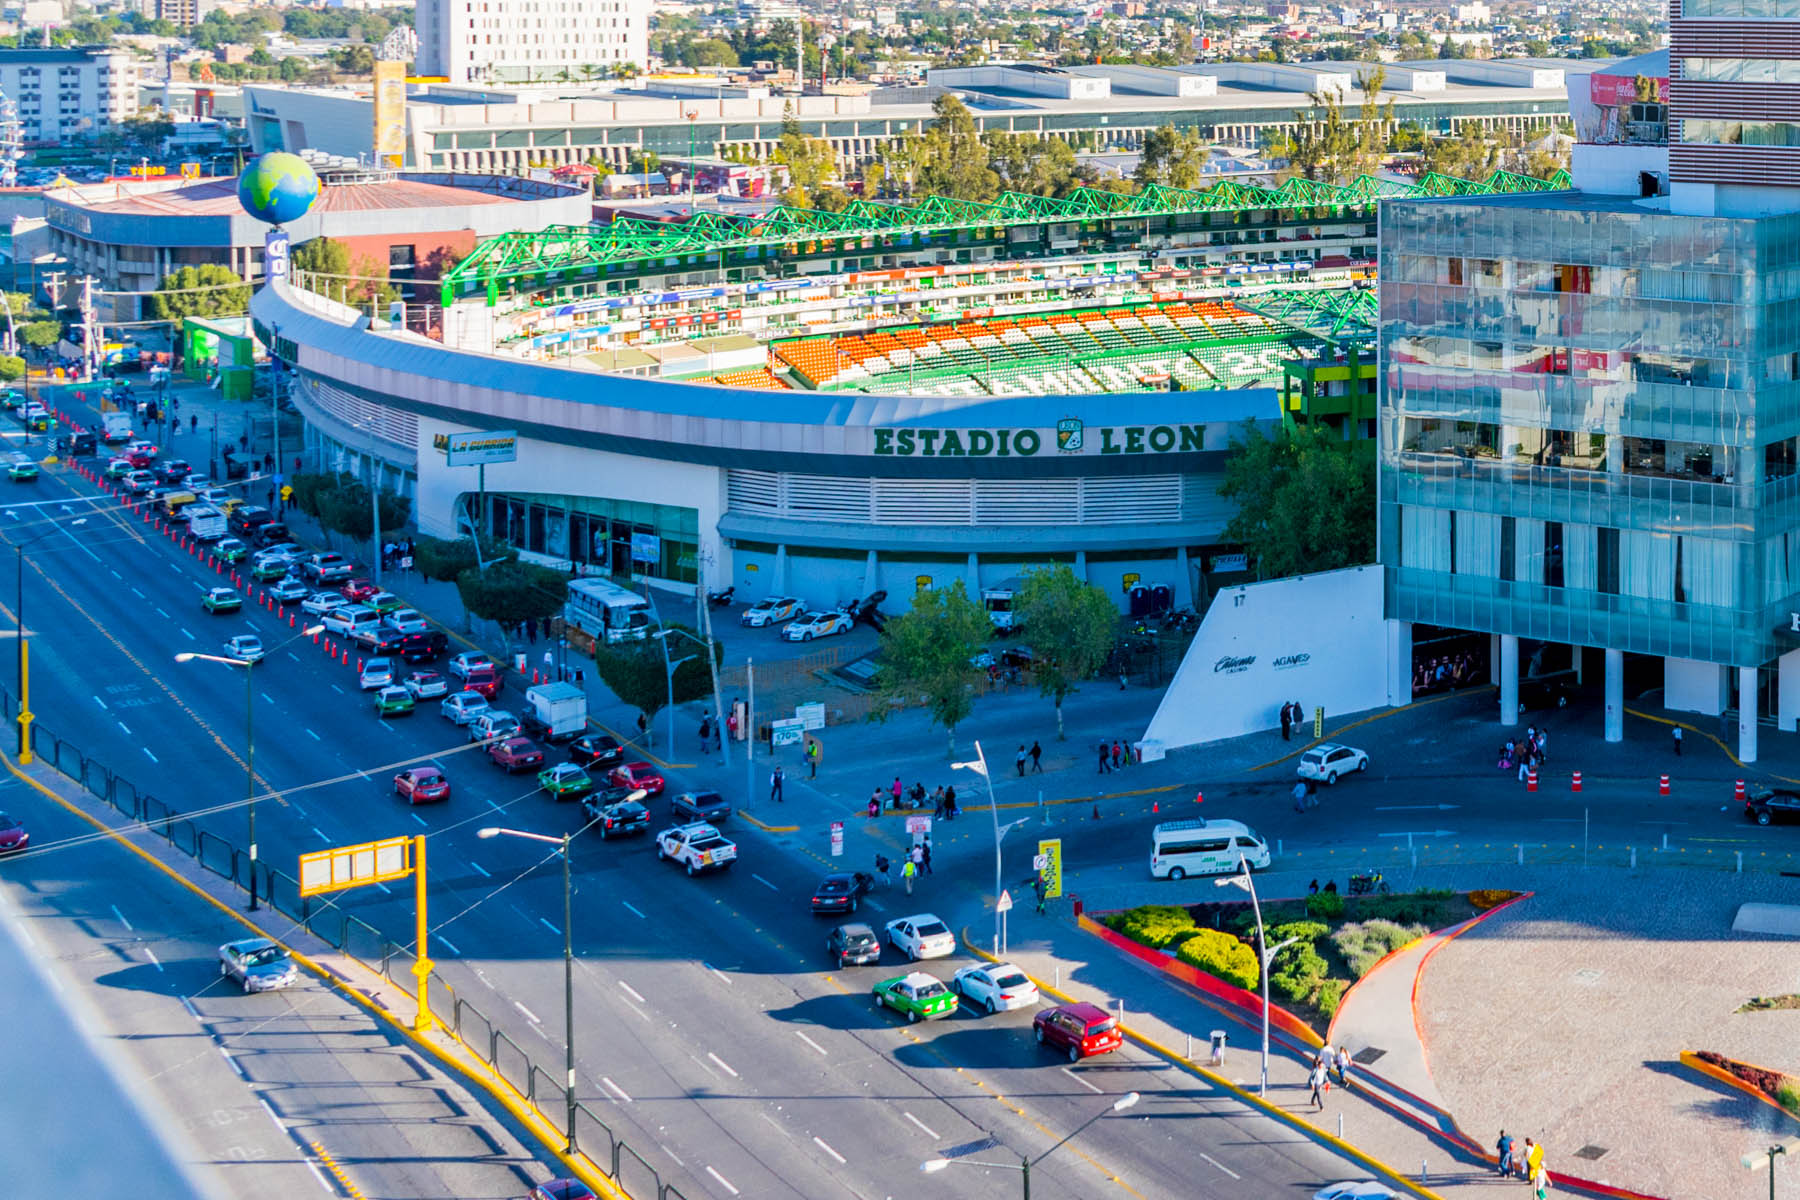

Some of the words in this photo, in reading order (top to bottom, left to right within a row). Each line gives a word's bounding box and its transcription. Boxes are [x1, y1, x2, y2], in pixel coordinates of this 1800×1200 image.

[874, 427, 1041, 457] ESTADIO
[1101, 423, 1206, 455] LEON
[1234, 594, 1246, 607] 17
